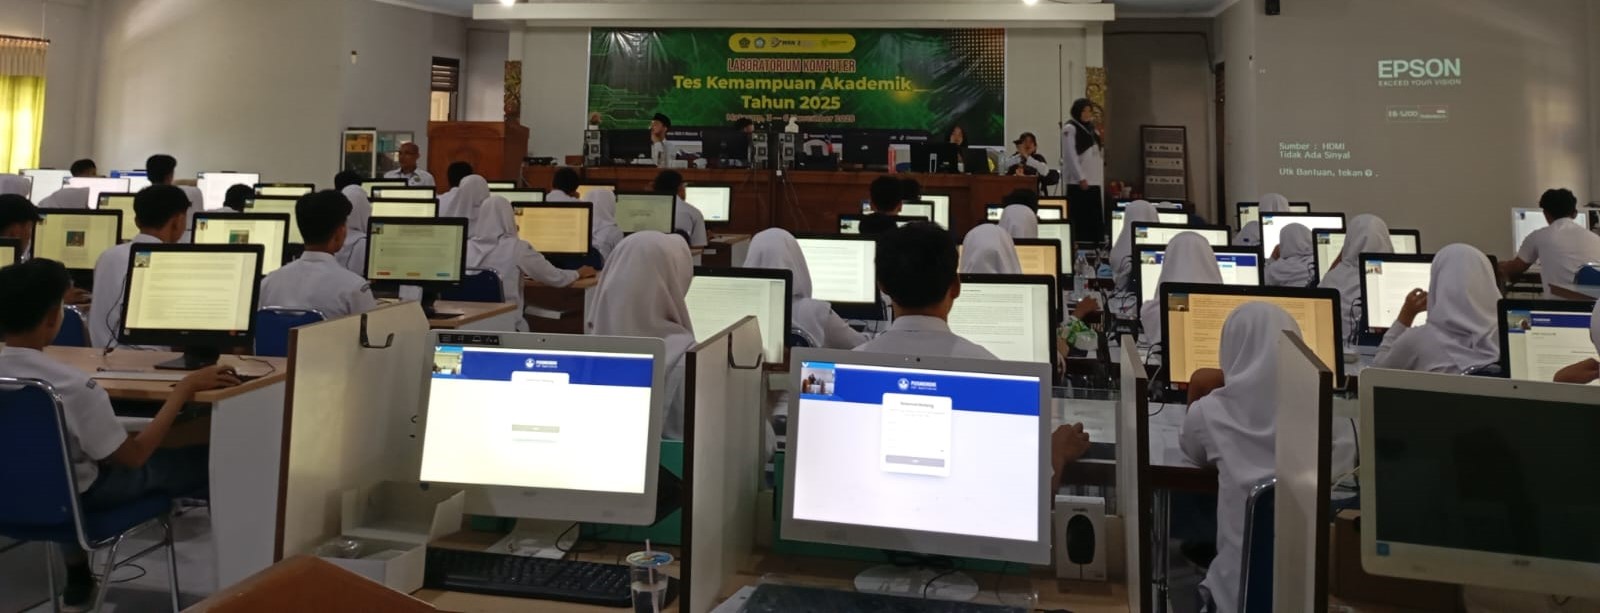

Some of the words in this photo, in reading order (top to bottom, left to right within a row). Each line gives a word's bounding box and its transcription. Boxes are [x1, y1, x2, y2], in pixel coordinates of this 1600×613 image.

[727, 58, 801, 73] LABORATORIUM
[802, 59, 856, 74] KOMPUTER
[1378, 58, 1461, 78] EPSON
[673, 75, 702, 89] Tes
[706, 76, 816, 92] Kemampuan
[821, 76, 911, 90] Akademik
[741, 95, 795, 109] Tahun
[800, 96, 841, 109] 2025
[1280, 142, 1309, 150] Sumber
[1322, 142, 1345, 150] HDMI
[1280, 150, 1301, 159] Tidak
[1304, 151, 1321, 159] Ada
[1324, 151, 1350, 160] Sinyal
[1280, 168, 1294, 176] Utk
[1296, 168, 1335, 177] Bantuan,
[1338, 168, 1363, 177] tekan
